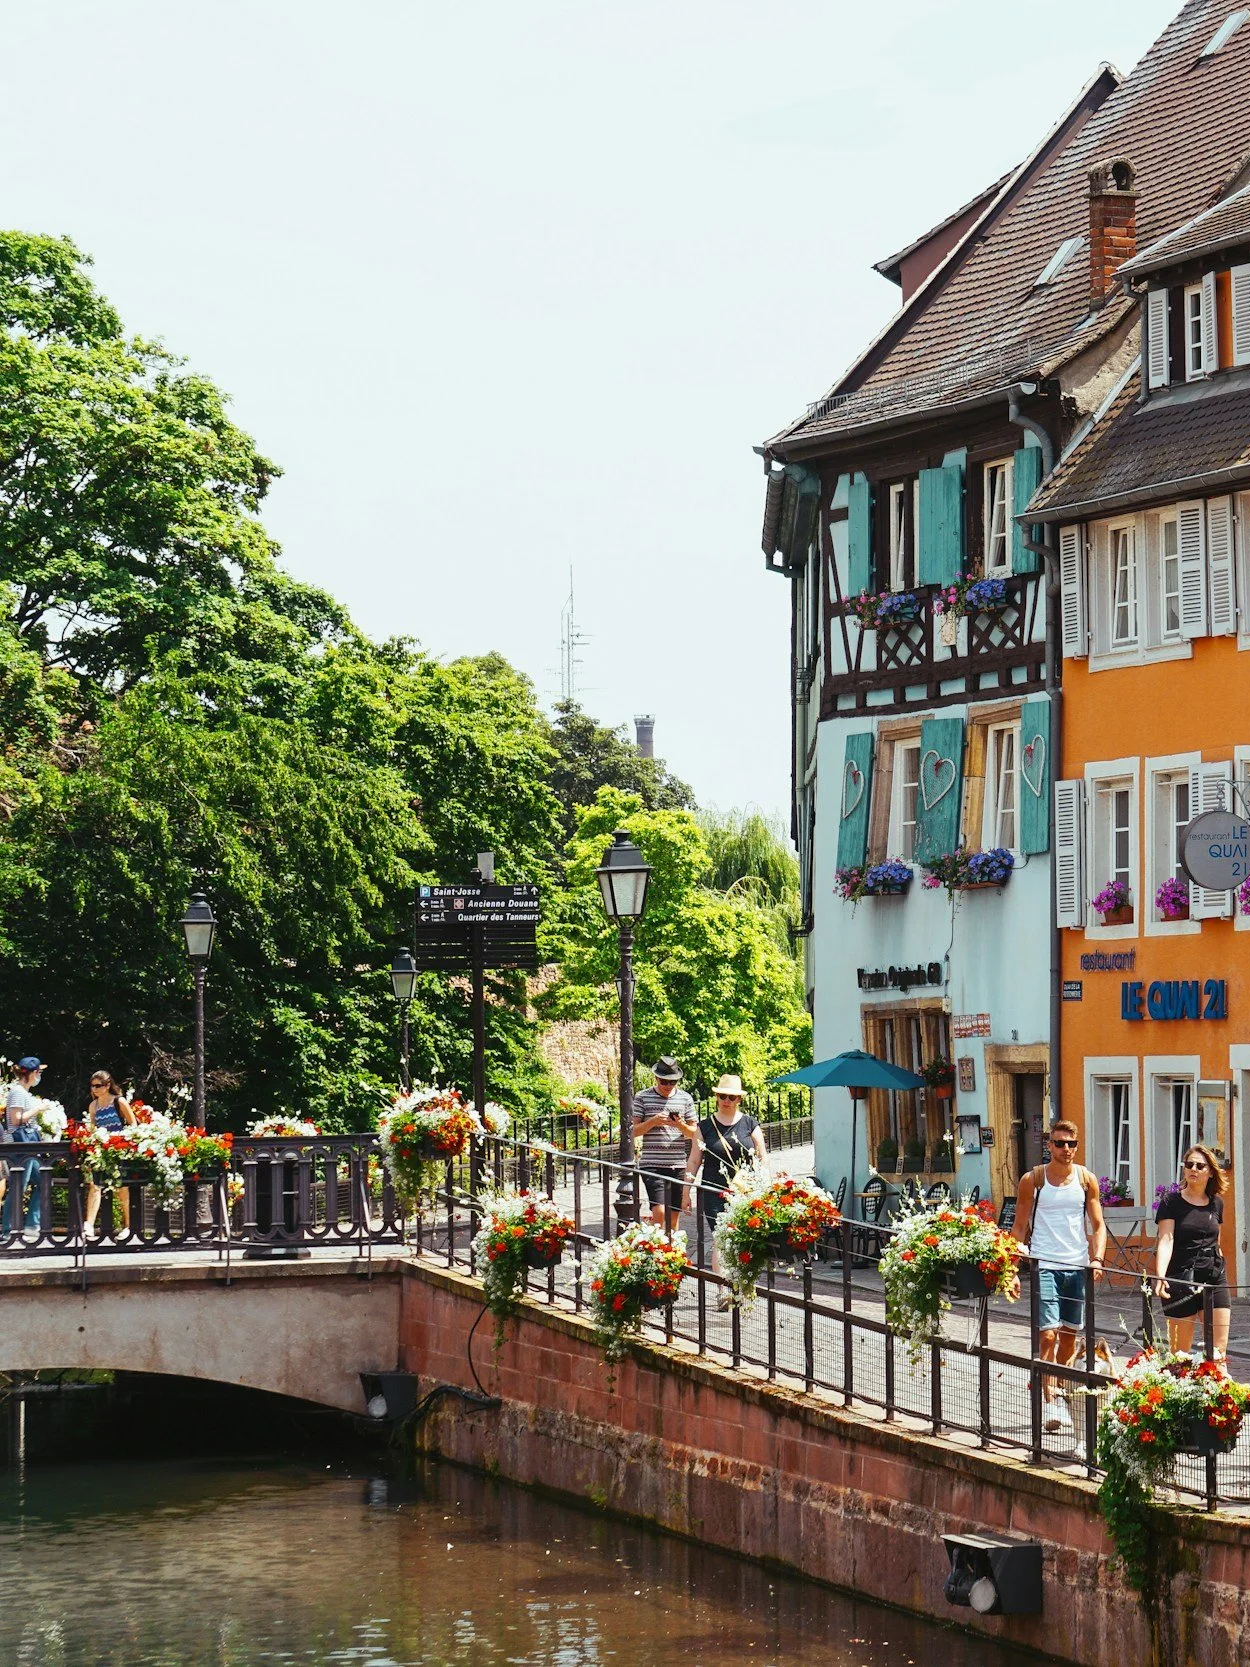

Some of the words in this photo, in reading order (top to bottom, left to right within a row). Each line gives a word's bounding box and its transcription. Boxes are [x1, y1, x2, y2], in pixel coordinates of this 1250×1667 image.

[1190, 832, 1231, 840] restaurant
[1232, 826, 1248, 839] LE
[1208, 844, 1248, 858] QUAI
[1232, 862, 1247, 876] 21
[433, 887, 481, 896] Saint-Josse
[467, 899, 506, 908] Ancienne
[508, 899, 539, 908] Douane
[457, 912, 489, 921] Quartier
[490, 913, 504, 921] des
[506, 912, 539, 921] Tanneurs
[1080, 948, 1137, 971] restaurant
[1121, 981, 1145, 1021] LE
[1147, 980, 1201, 1021] QUAI
[1203, 978, 1229, 1021] 21
